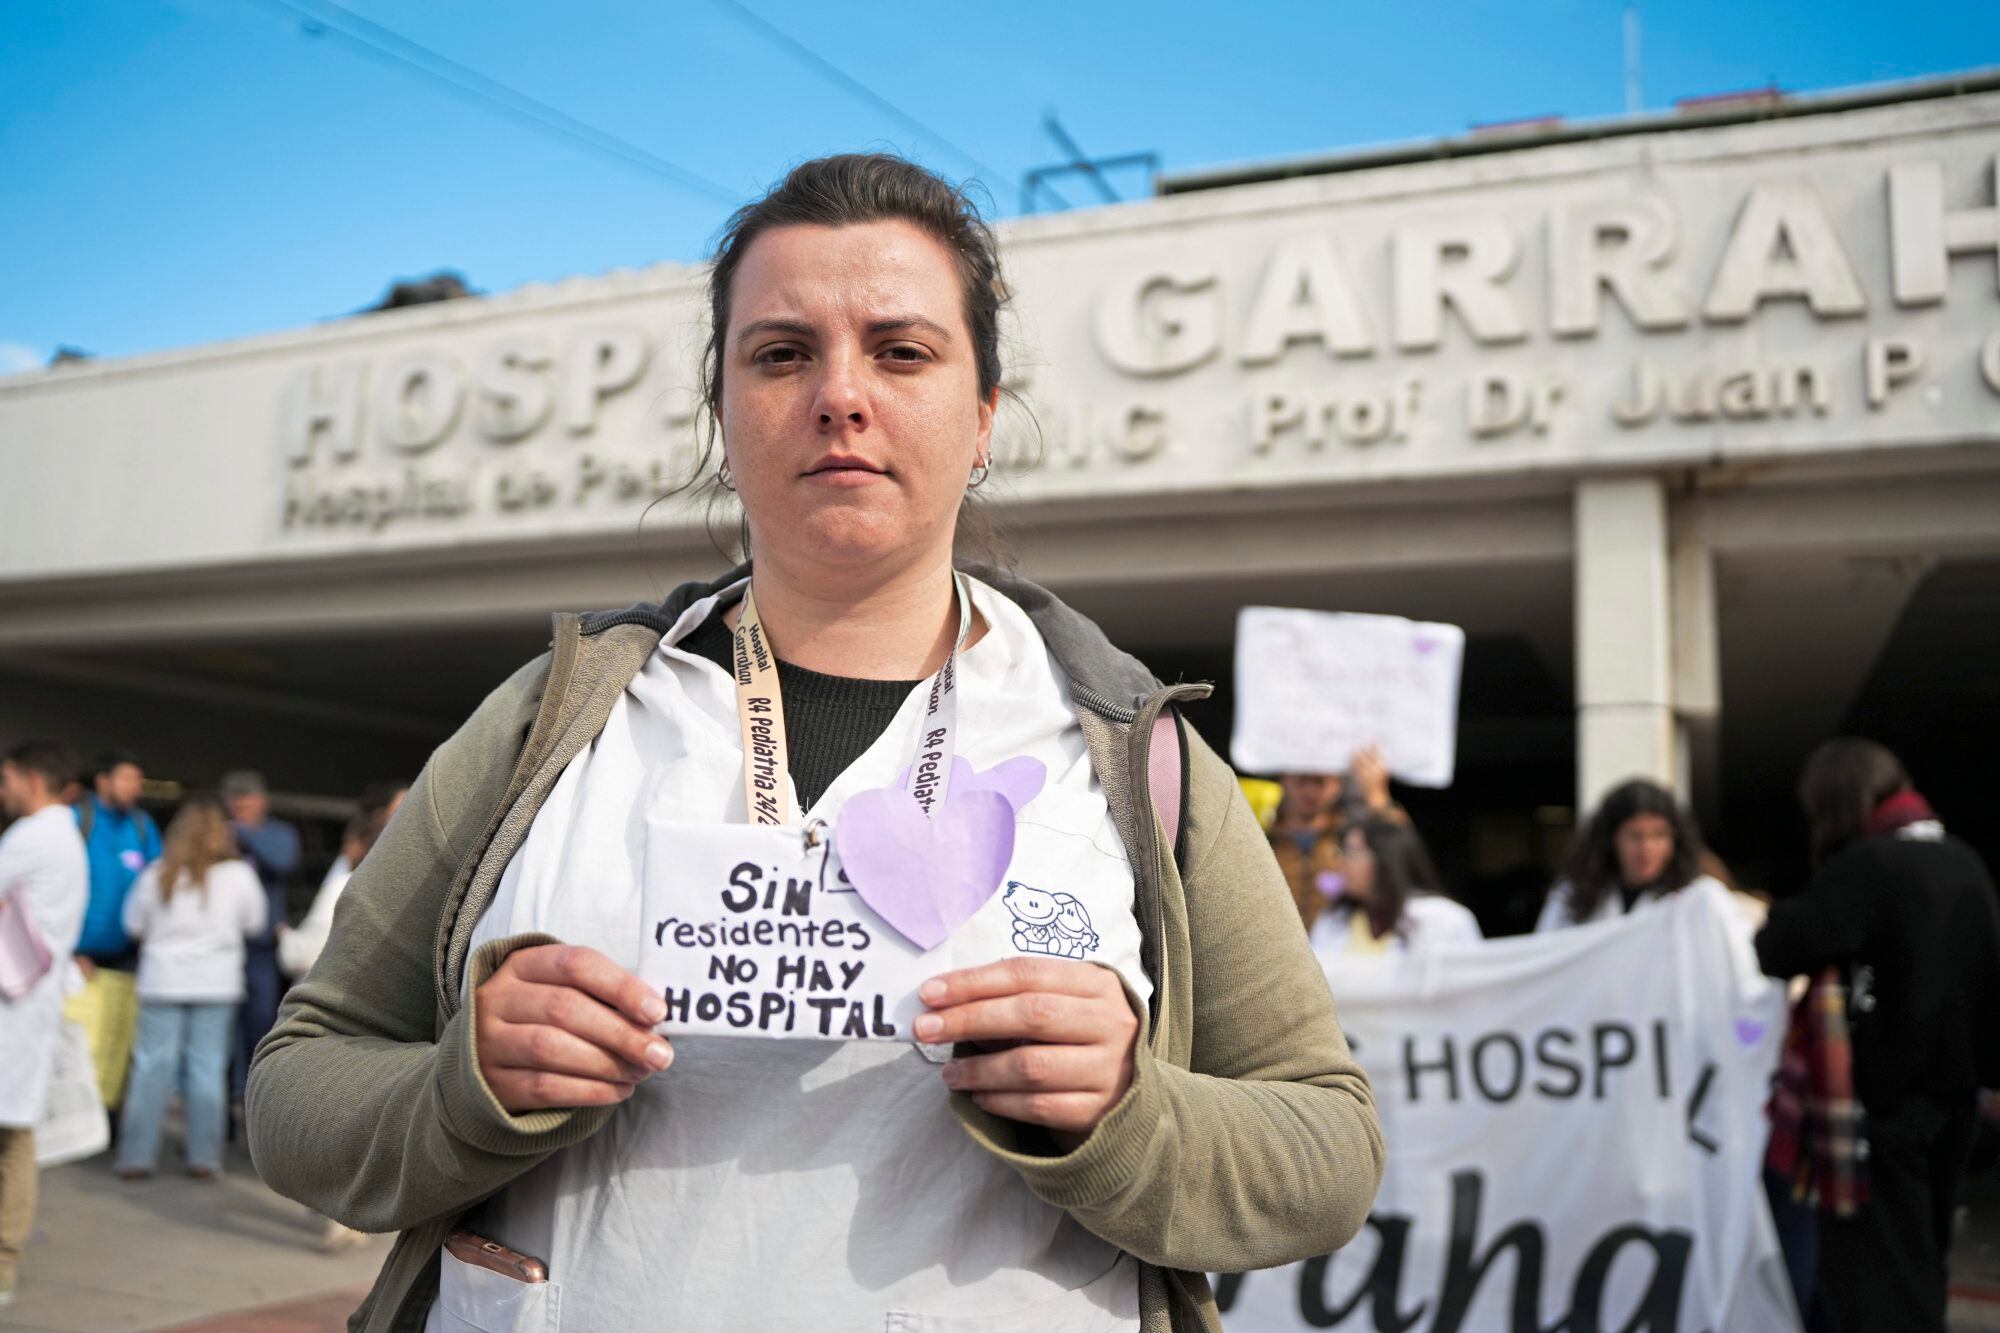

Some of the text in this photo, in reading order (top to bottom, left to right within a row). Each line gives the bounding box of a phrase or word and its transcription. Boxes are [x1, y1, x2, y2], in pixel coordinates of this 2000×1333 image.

[1610, 352, 1830, 430] Juan
[735, 626, 753, 686] Garrahan
[749, 622, 772, 673] Hospital
[747, 697, 772, 714] R4
[924, 727, 947, 749] R4
[655, 917, 871, 950] residentes
[708, 954, 865, 992] NO HAY
